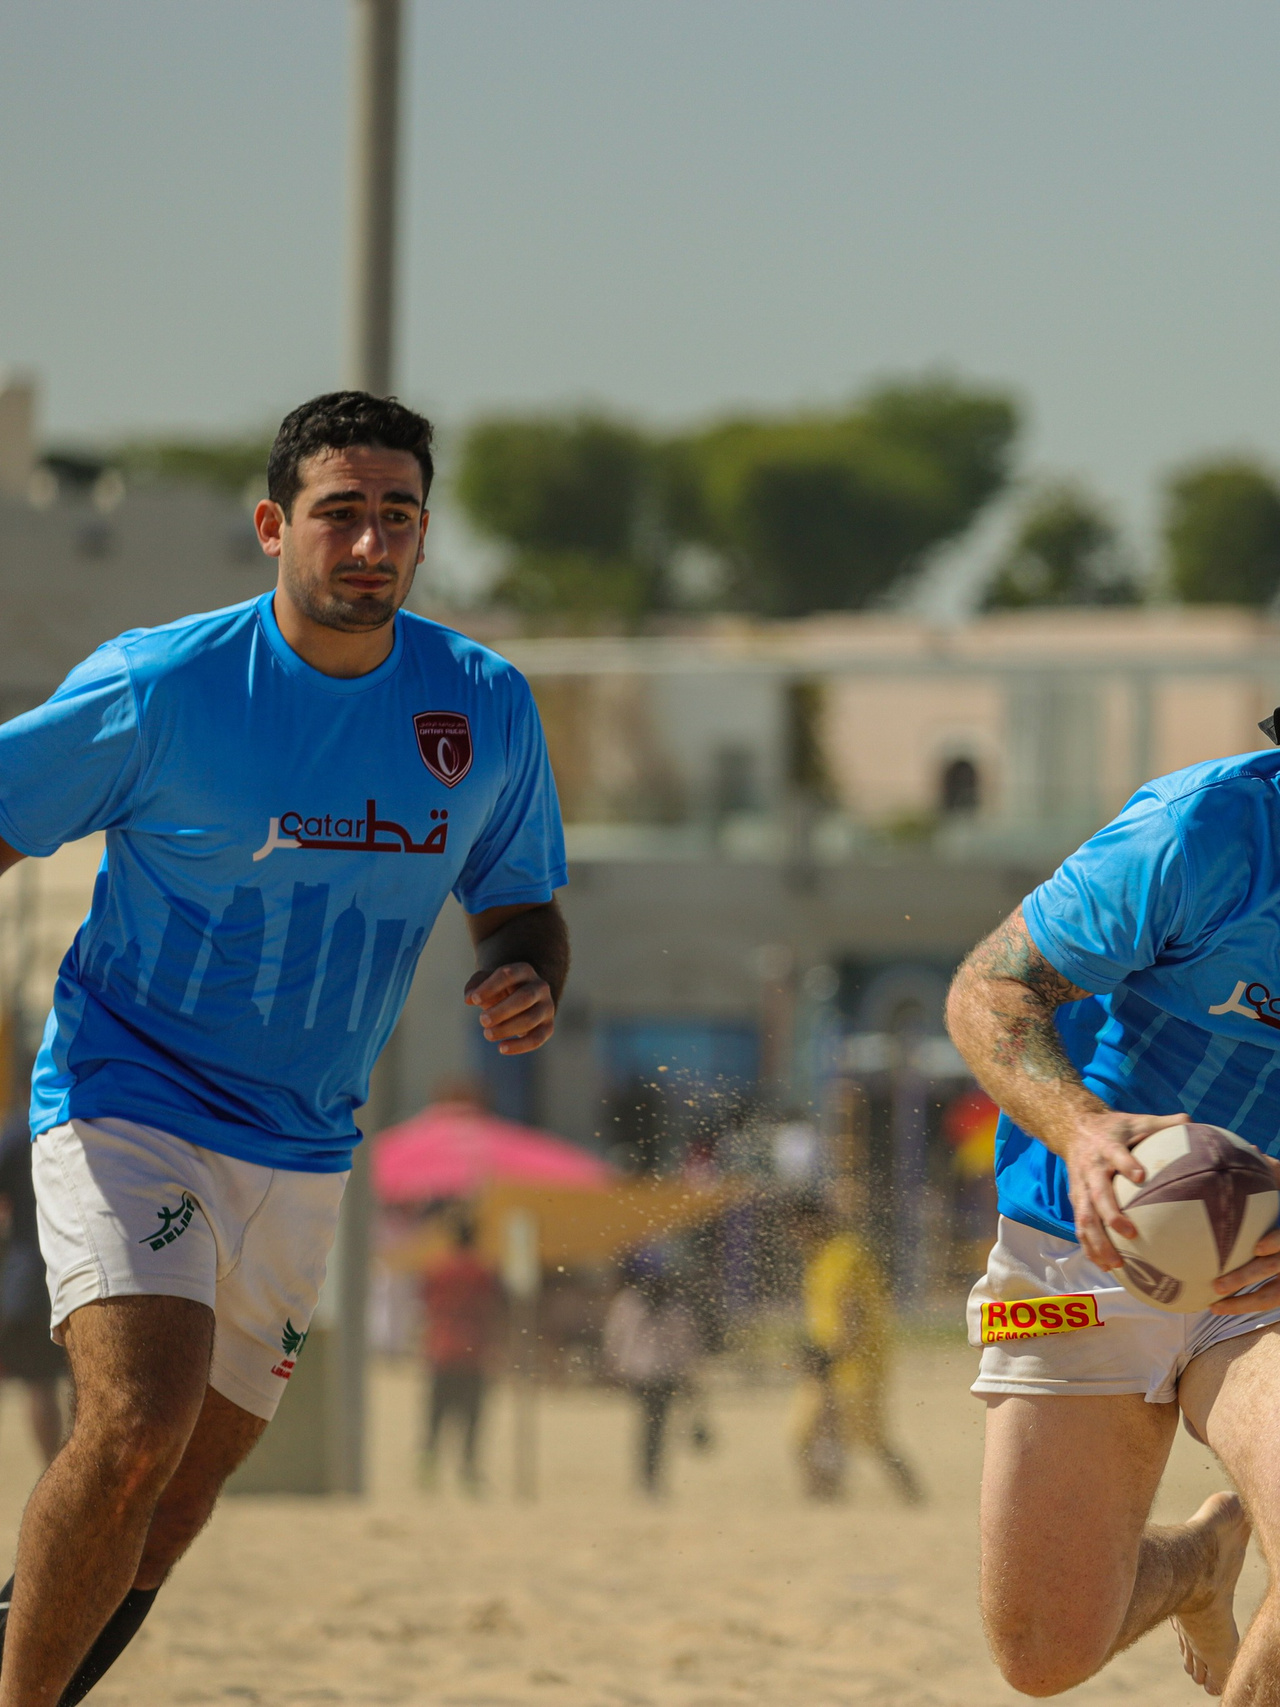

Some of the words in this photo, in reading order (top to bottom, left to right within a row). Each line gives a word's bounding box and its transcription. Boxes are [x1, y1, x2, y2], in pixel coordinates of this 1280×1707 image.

[252, 799, 449, 862] قطر
[280, 811, 366, 842] Qatar
[149, 1198, 195, 1251] BELIEF
[988, 1302, 1089, 1328] ROSS
